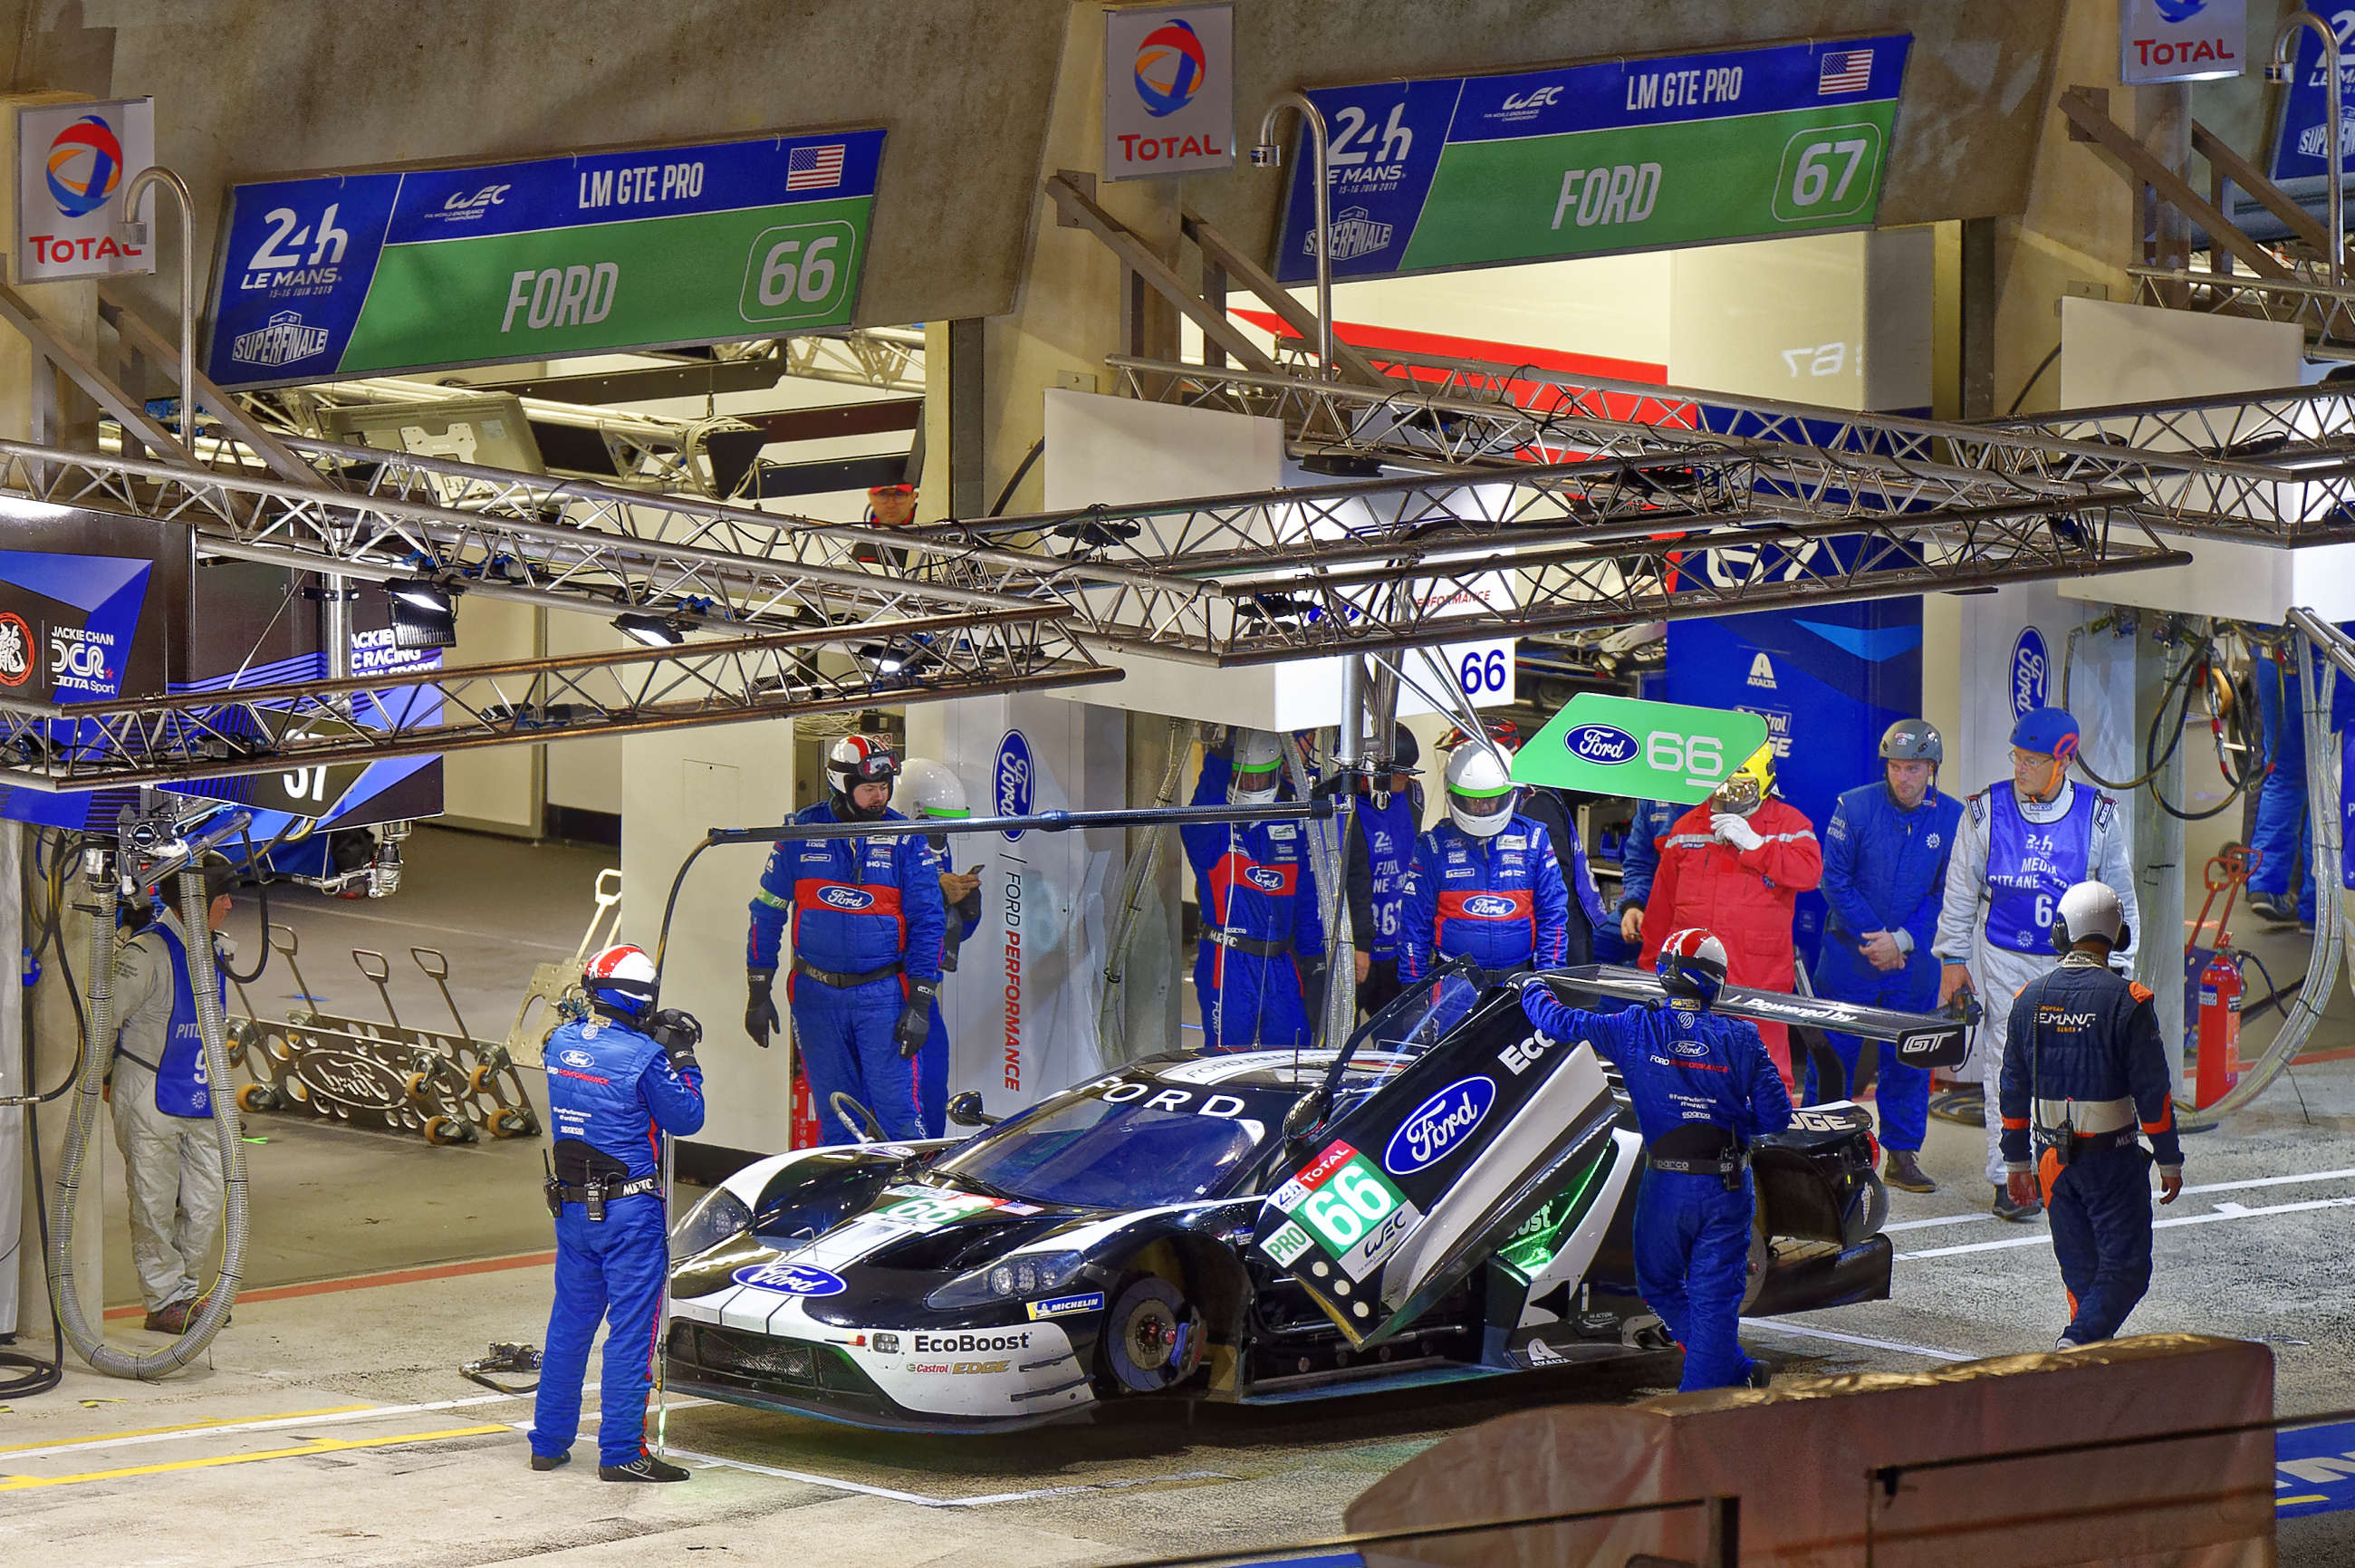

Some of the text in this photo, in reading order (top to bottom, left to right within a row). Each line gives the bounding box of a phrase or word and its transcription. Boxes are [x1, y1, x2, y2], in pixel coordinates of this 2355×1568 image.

[2134, 39, 2235, 66] TOTAL
[1502, 86, 1565, 110] WEC
[1626, 66, 1744, 111] LM GTE PRO
[1118, 133, 1222, 161] TOTAL
[1329, 102, 1413, 166] 24h
[579, 161, 705, 208] LM GTE PRO
[1341, 164, 1402, 183] MANS
[1792, 139, 1867, 206] 67
[444, 184, 511, 209] WEC
[1552, 163, 1662, 230] FORD
[247, 203, 348, 270] 24h
[1306, 221, 1391, 257] SERFINALE
[241, 268, 339, 290] LE MANS
[758, 236, 838, 306] 66
[500, 262, 619, 332] FORD
[235, 323, 329, 364] SUPERFINALE
[52, 625, 114, 646] JACKIE CHAN
[351, 628, 393, 649] ACKIE
[363, 648, 421, 669] RACING
[1461, 649, 1507, 695] 66
[52, 675, 115, 694] JOTA Sport
[1746, 676, 1777, 689] AXALTA
[2017, 648, 2044, 712] Ford
[1579, 728, 1723, 775] Ford 66
[1373, 860, 1400, 876] FUEL
[2021, 858, 2058, 875] MEDIA
[828, 889, 863, 909] Ford
[1471, 896, 1506, 914] Ford
[1004, 871, 1021, 1092] FORD PERFORMANCE
[1743, 997, 1857, 1022] Powered by
[1675, 1043, 1701, 1055] Ford
[1902, 1031, 1957, 1054] GT
[565, 1051, 590, 1066] Ford
[1649, 1055, 1729, 1073] FORD PERFORMANCE
[1076, 1075, 1245, 1118] FORD
[1407, 1092, 1478, 1162] Ford
[1682, 1111, 1711, 1120] sparco
[1301, 1147, 1351, 1185] TOTAL
[1304, 1165, 1392, 1246] 66
[1266, 1226, 1307, 1262] PRO
[1364, 1210, 1407, 1259] WEC
[748, 1265, 825, 1294] Ford
[1051, 1298, 1099, 1312] MICHELIN
[915, 1333, 1030, 1353] EcoBoost
[916, 1360, 1011, 1375] Castrol EDGE
